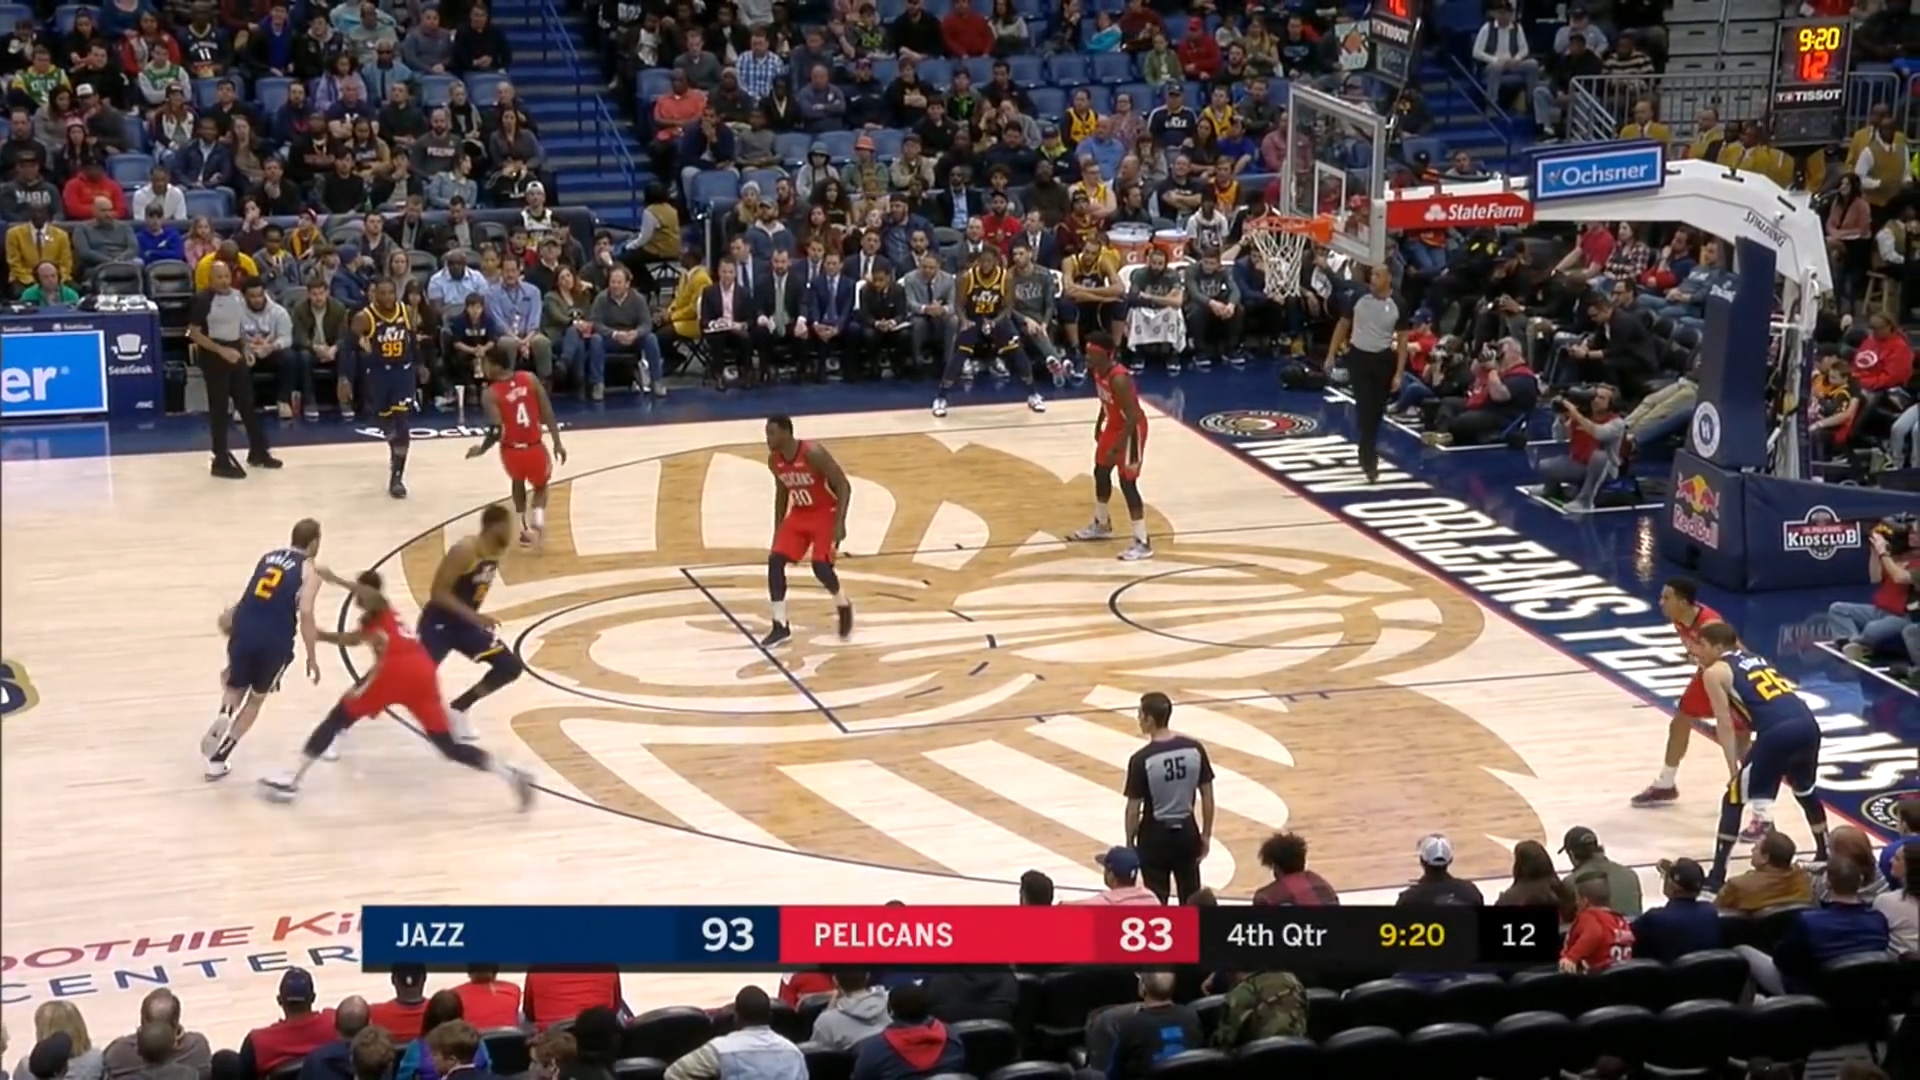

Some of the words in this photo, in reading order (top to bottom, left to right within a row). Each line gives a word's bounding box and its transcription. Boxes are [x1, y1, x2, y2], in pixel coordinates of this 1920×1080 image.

[1800, 27, 1839, 52] 9:20
[1803, 51, 1829, 80] 12
[1795, 89, 1842, 101] TISSOT
[1562, 164, 1648, 186] Ochsner
[381, 341, 403, 357] 99
[108, 364, 152, 376] SeatGeek
[516, 402, 530, 428] 4
[1342, 497, 1651, 620] ORLEANS
[254, 566, 283, 599] 2
[1747, 667, 1799, 700] 26
[1163, 756, 1187, 782] 35
[273, 910, 362, 941] Ki
